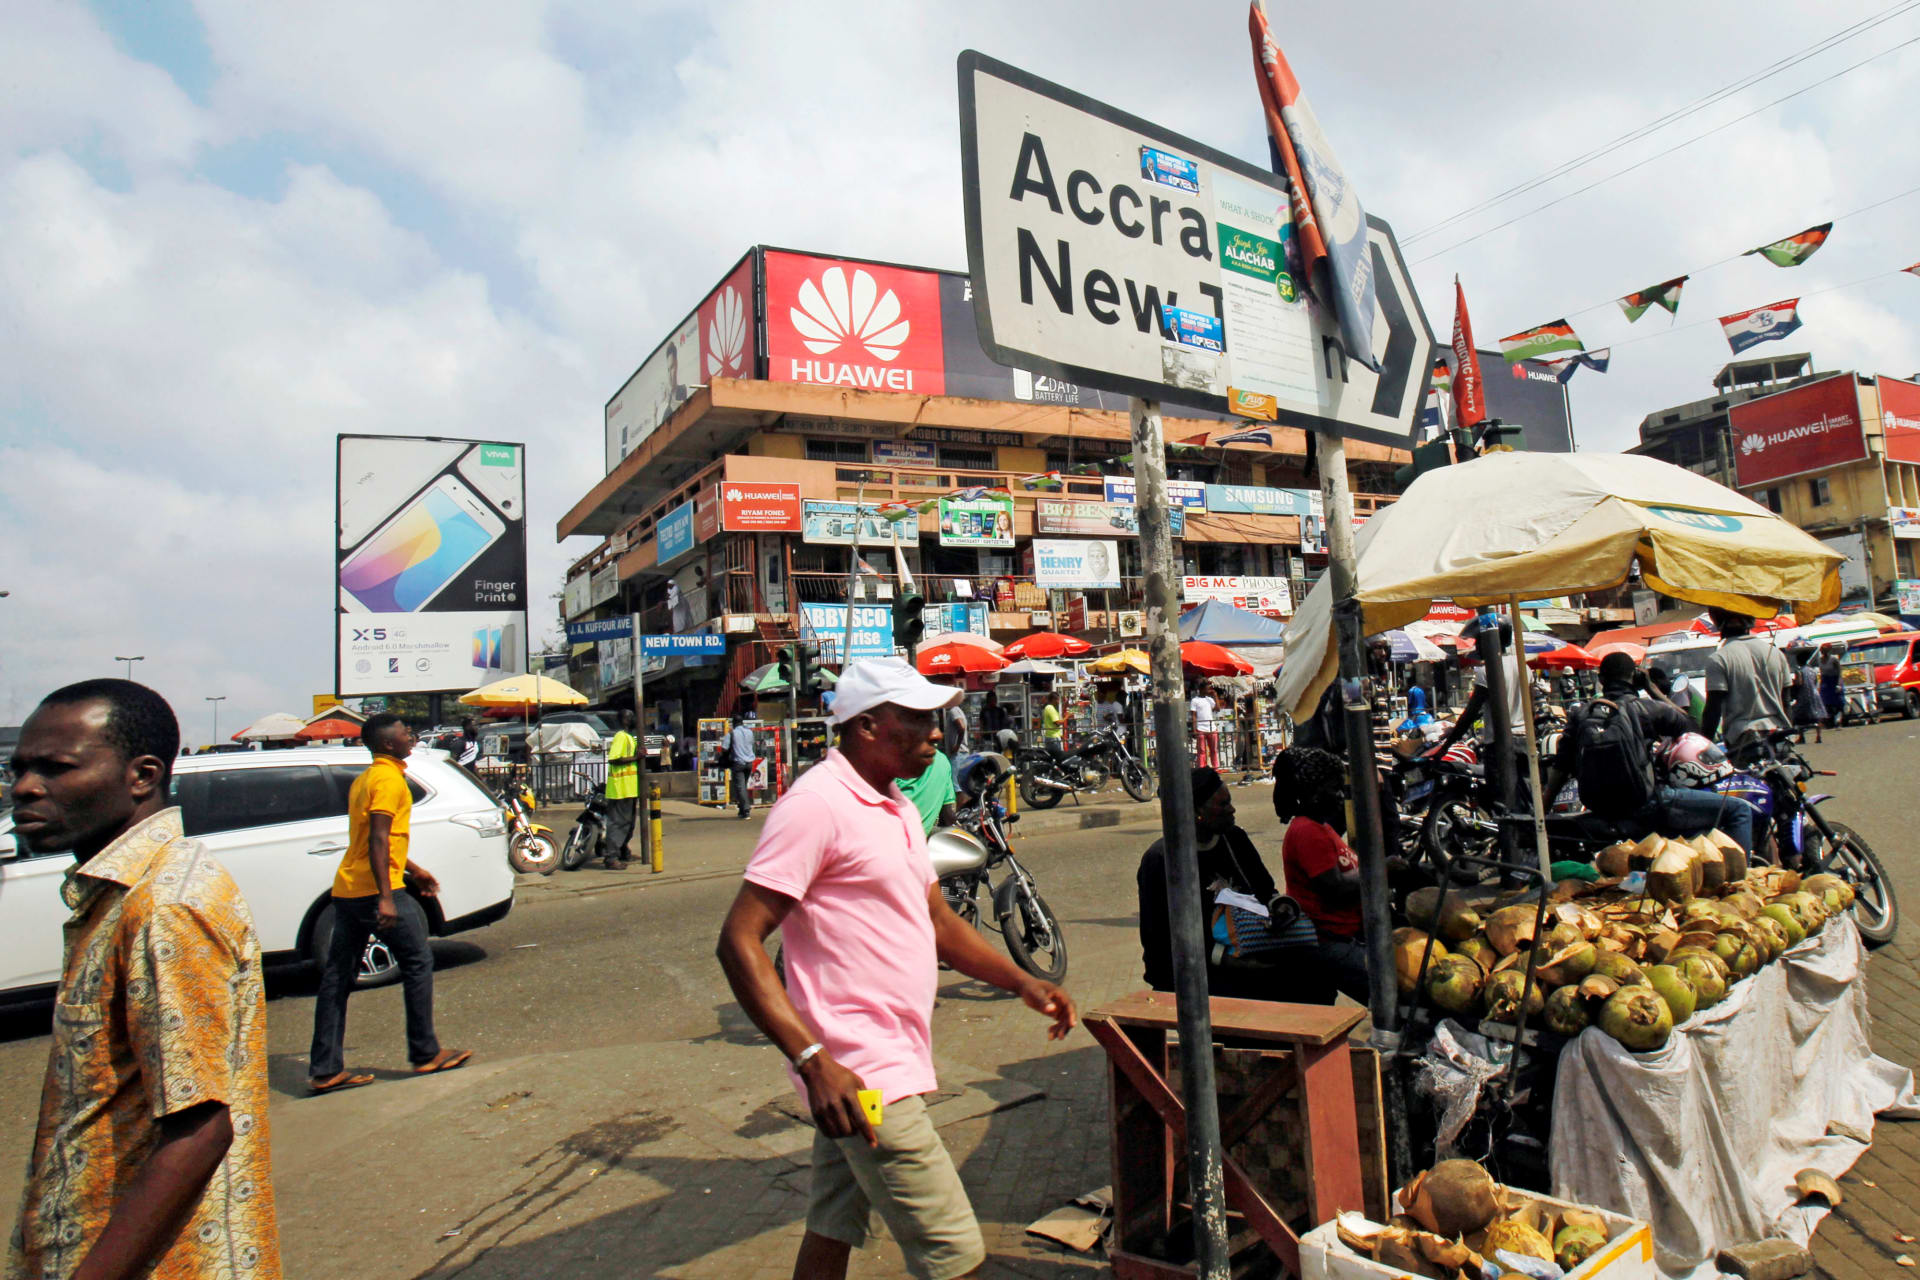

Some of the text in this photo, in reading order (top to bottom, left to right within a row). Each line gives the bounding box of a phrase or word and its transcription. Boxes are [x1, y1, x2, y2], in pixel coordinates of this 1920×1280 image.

[1010, 131, 1212, 262] Accra
[1225, 246, 1276, 271] ALACHAB
[1017, 227, 1178, 337] New
[791, 359, 913, 390] HUAWEI
[1035, 391, 1080, 404] BATTERY LIFE
[1464, 376, 1476, 413] PARTY
[951, 431, 983, 443] PHONE
[986, 433, 1022, 446] PEOPLE
[1768, 421, 1825, 445] HUAWEI
[744, 492, 780, 500] HUAWEI
[1225, 487, 1294, 505] SAMSUNG
[1042, 503, 1073, 517] BIG
[1040, 556, 1083, 569] HENRY
[475, 580, 516, 592] Finger
[1186, 577, 1289, 589] BIG M.C PHONES
[475, 592, 506, 602] Print
[585, 619, 617, 632] KUFFOUR
[617, 618, 633, 629] AVE.
[352, 642, 384, 651] Android
[399, 641, 450, 650] Marshmallow
[645, 635, 722, 648] NEW TOWN RD.
